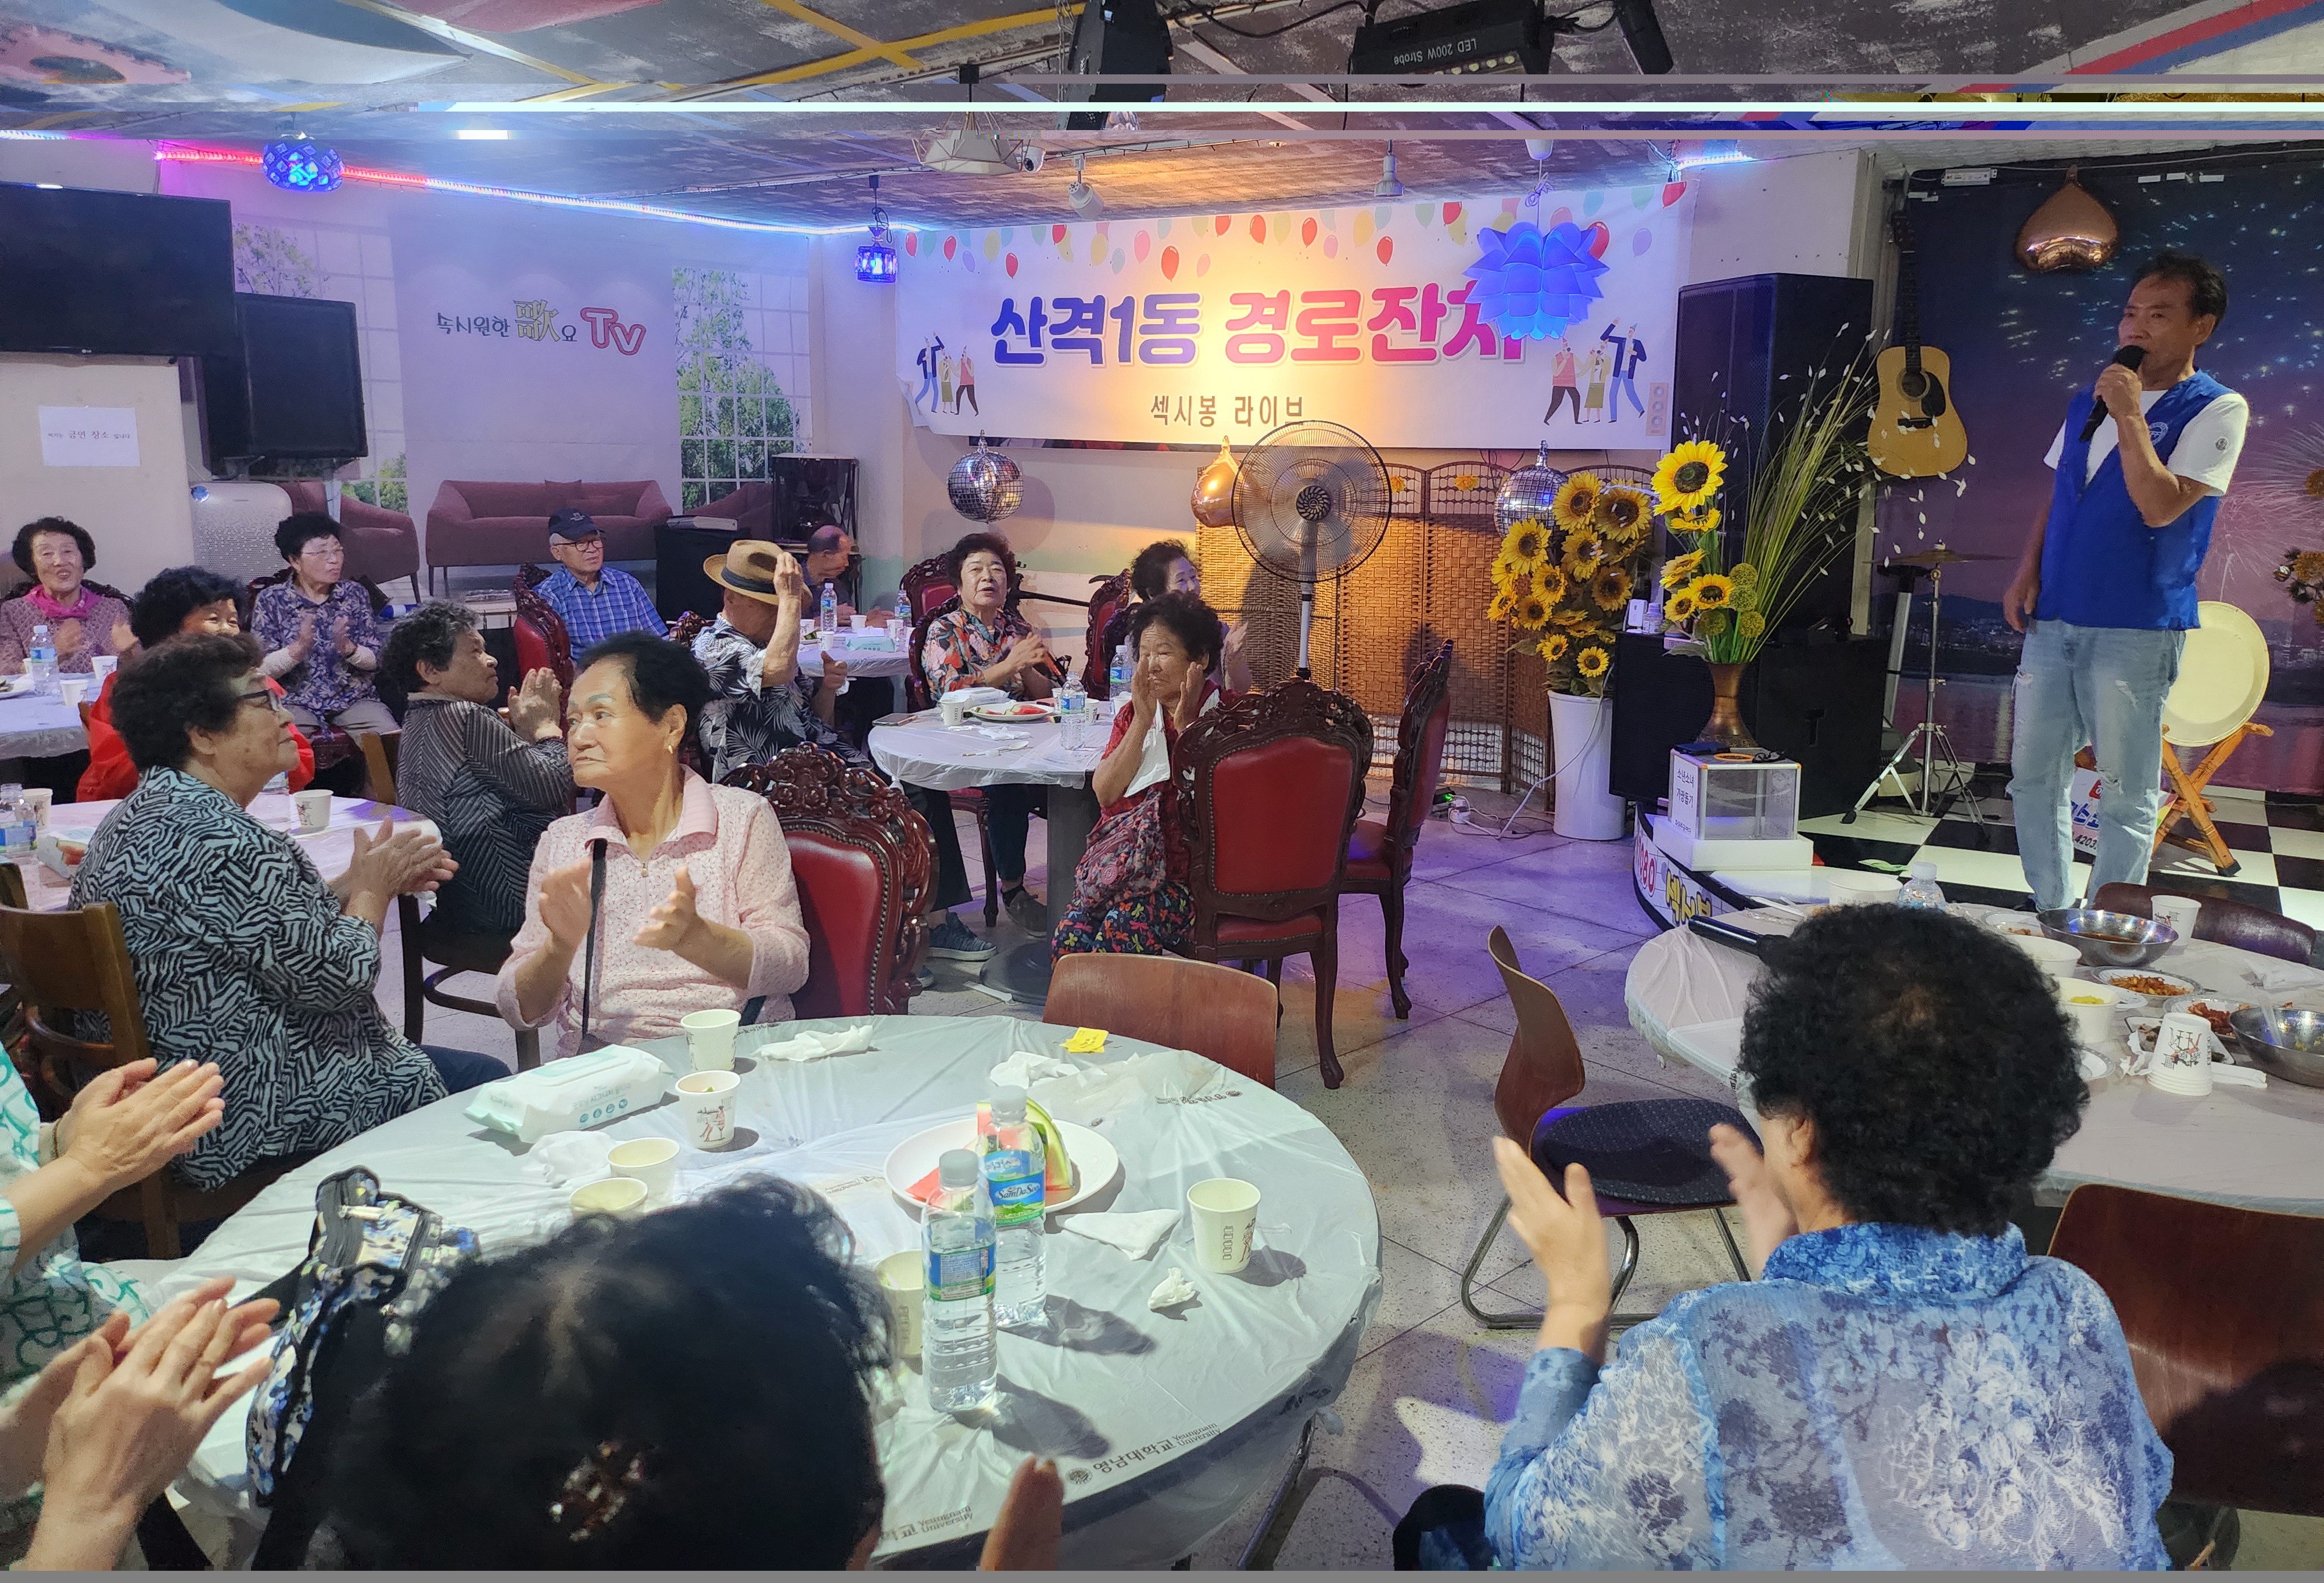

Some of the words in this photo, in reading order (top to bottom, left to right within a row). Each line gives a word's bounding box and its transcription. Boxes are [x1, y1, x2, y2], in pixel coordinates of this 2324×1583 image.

[1428, 43, 1453, 60] 200W
[1457, 38, 1477, 53] LED
[1394, 51, 1423, 66] Strobe
[436, 313, 511, 338] 속시원한
[991, 294, 1201, 365] 산격1동
[1150, 395, 1217, 428] 섹시봉
[1235, 396, 1303, 428] 라이브
[69, 430, 87, 440] 금연
[1677, 768, 1694, 788] 소년소녀
[1178, 1427, 1221, 1446] University
[1092, 1438, 1178, 1474] 영남대학교
[1171, 1422, 1218, 1441] Yeungnam
